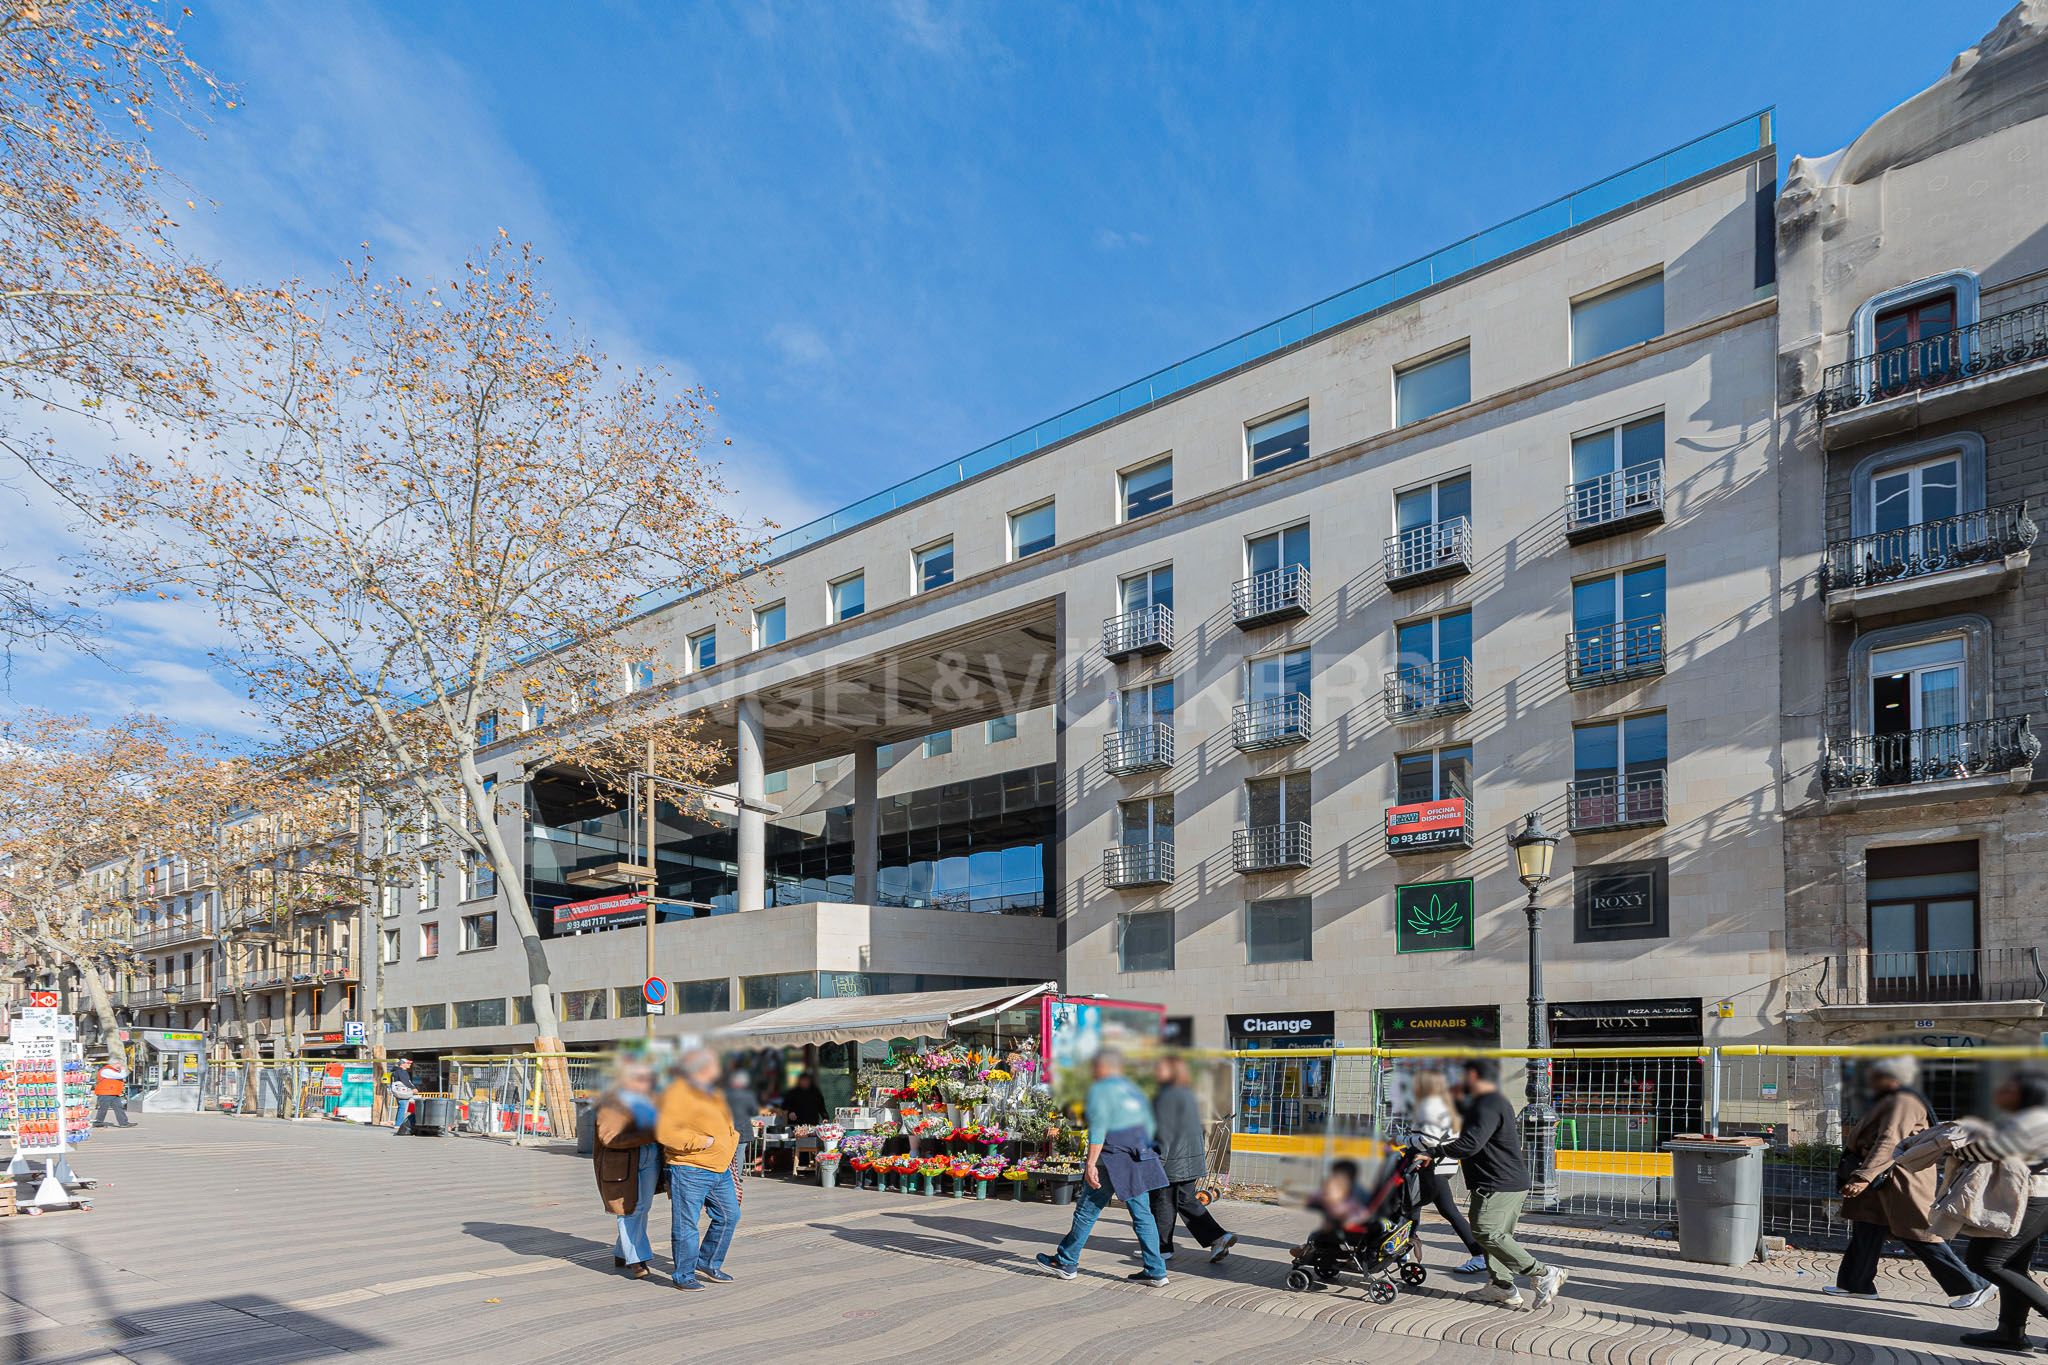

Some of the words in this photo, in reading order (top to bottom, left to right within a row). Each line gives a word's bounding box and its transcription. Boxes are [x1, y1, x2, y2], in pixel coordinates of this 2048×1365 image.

[1421, 811, 1461, 822] DISPONIBLE
[1427, 806, 1455, 815] OFICINA
[1401, 834, 1414, 843] 93
[1415, 832, 1433, 841] 481
[1434, 830, 1446, 839] 71
[1447, 828, 1460, 838] 71
[1594, 893, 1647, 909] ROXY
[572, 921, 580, 929] 93
[580, 918, 592, 928] 481
[592, 917, 599, 926] 71
[599, 916, 606, 925] 71
[1243, 1018, 1312, 1033] Change
[1410, 1019, 1467, 1028] CANNABIS
[1596, 1017, 1651, 1028] ROXY
